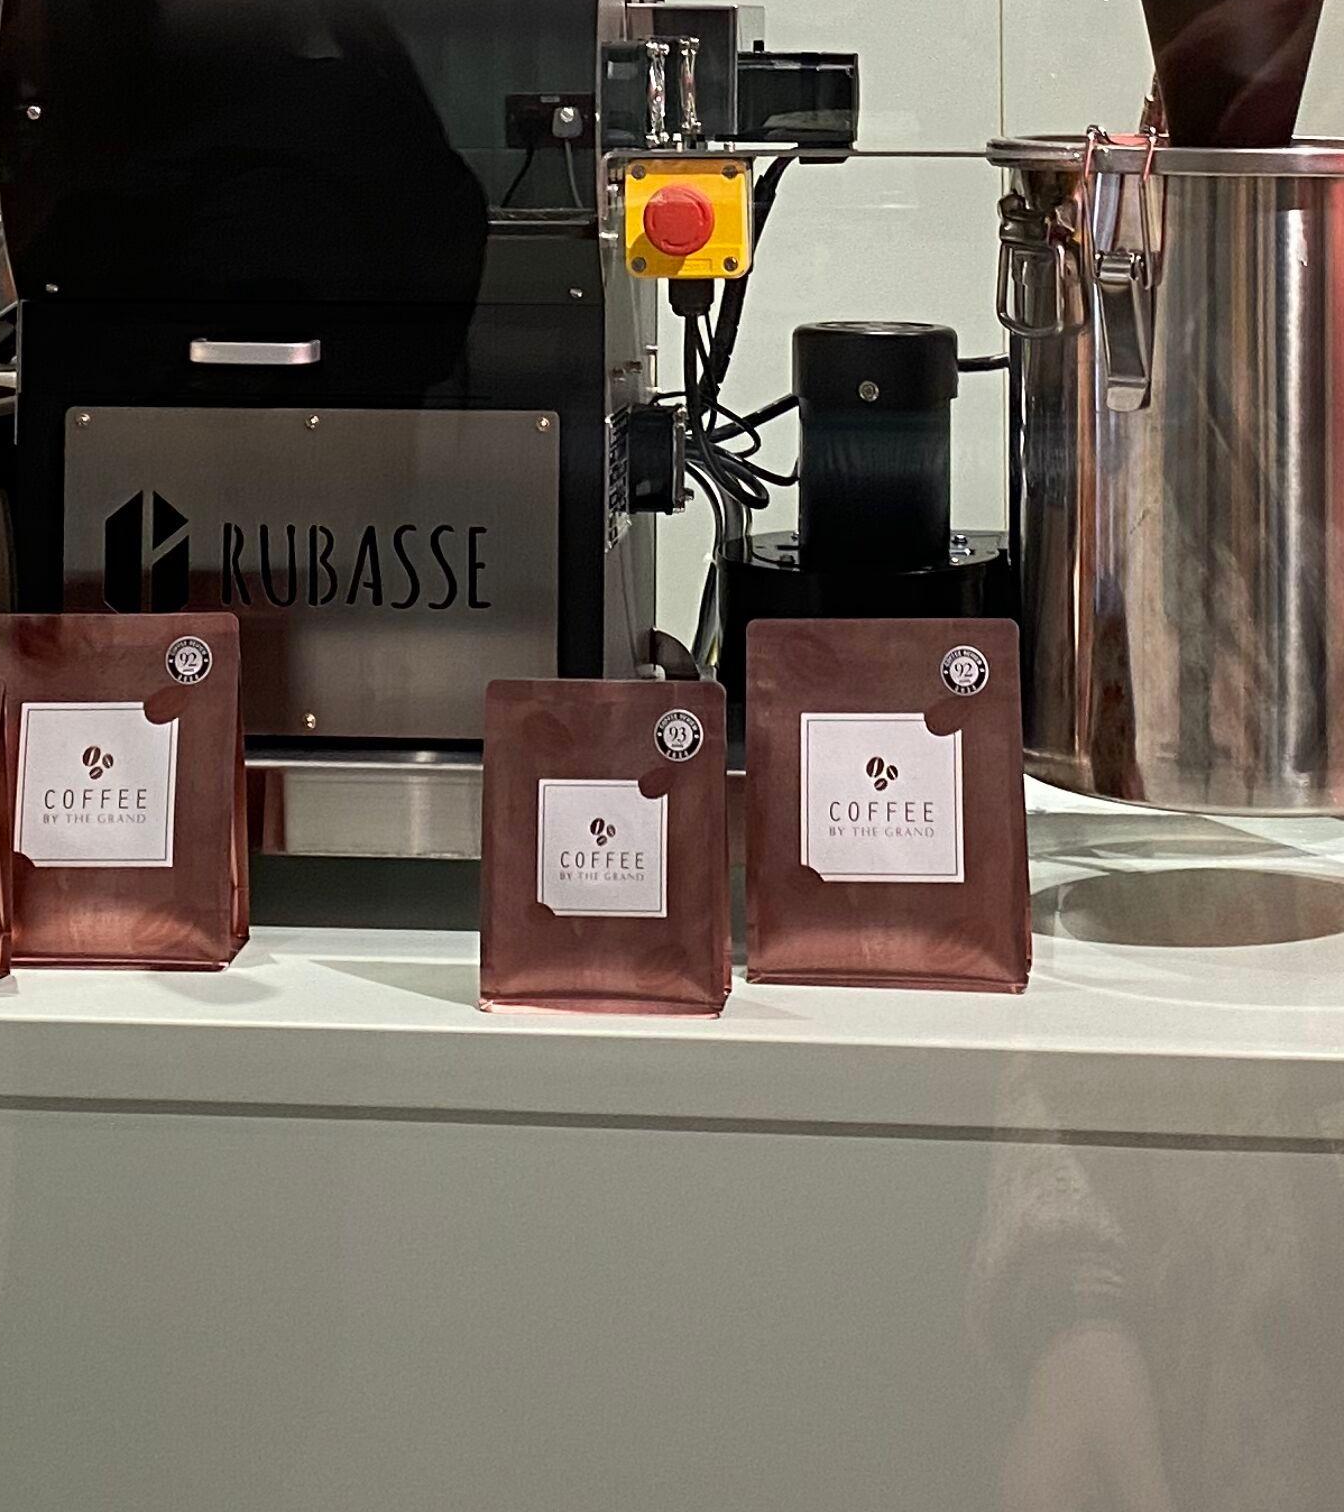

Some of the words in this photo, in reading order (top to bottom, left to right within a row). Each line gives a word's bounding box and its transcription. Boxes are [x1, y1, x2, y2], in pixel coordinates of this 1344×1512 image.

[219, 521, 493, 610] RUBASSE
[179, 652, 197, 666] 92
[954, 662, 973, 677] 92
[669, 726, 687, 742] 93
[44, 788, 147, 809] COFFEE
[42, 813, 59, 824] BY
[65, 813, 90, 824] THE
[97, 813, 147, 824] GRAND
[829, 801, 934, 822] COFFEE
[829, 827, 844, 837] BY
[852, 827, 878, 837] THE
[884, 827, 934, 837] GRAND
[560, 851, 645, 869] COFFEE
[559, 871, 572, 880] BY
[604, 872, 645, 881] GRAND
